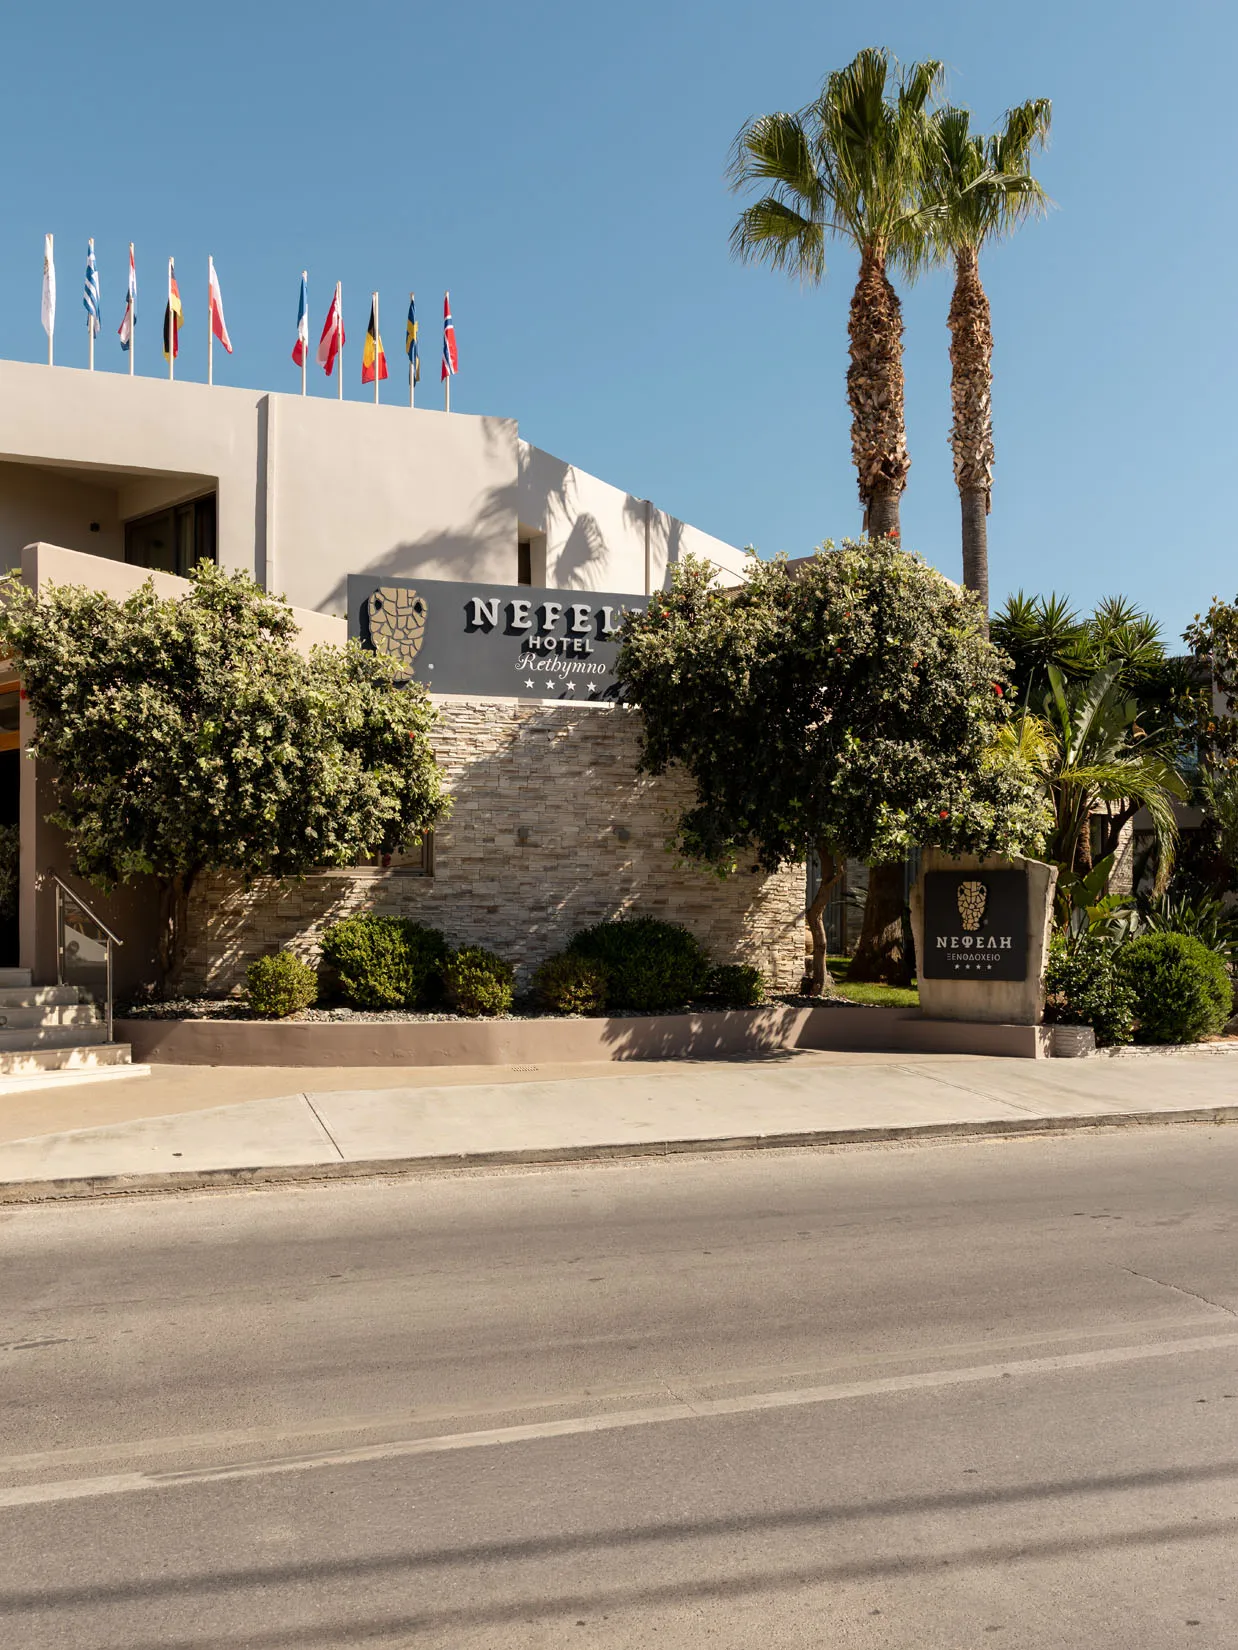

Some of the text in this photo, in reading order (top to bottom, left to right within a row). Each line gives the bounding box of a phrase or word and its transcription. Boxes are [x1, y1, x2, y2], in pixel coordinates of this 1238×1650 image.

[471, 597, 643, 635] NEFEL
[528, 635, 595, 653] HOTEL
[514, 651, 607, 680] Rethymno
[936, 935, 1012, 949] ΝΕΦΕΛΗ
[946, 953, 1001, 962] ΞΕΝΟΔΟΧΕΙΟ
